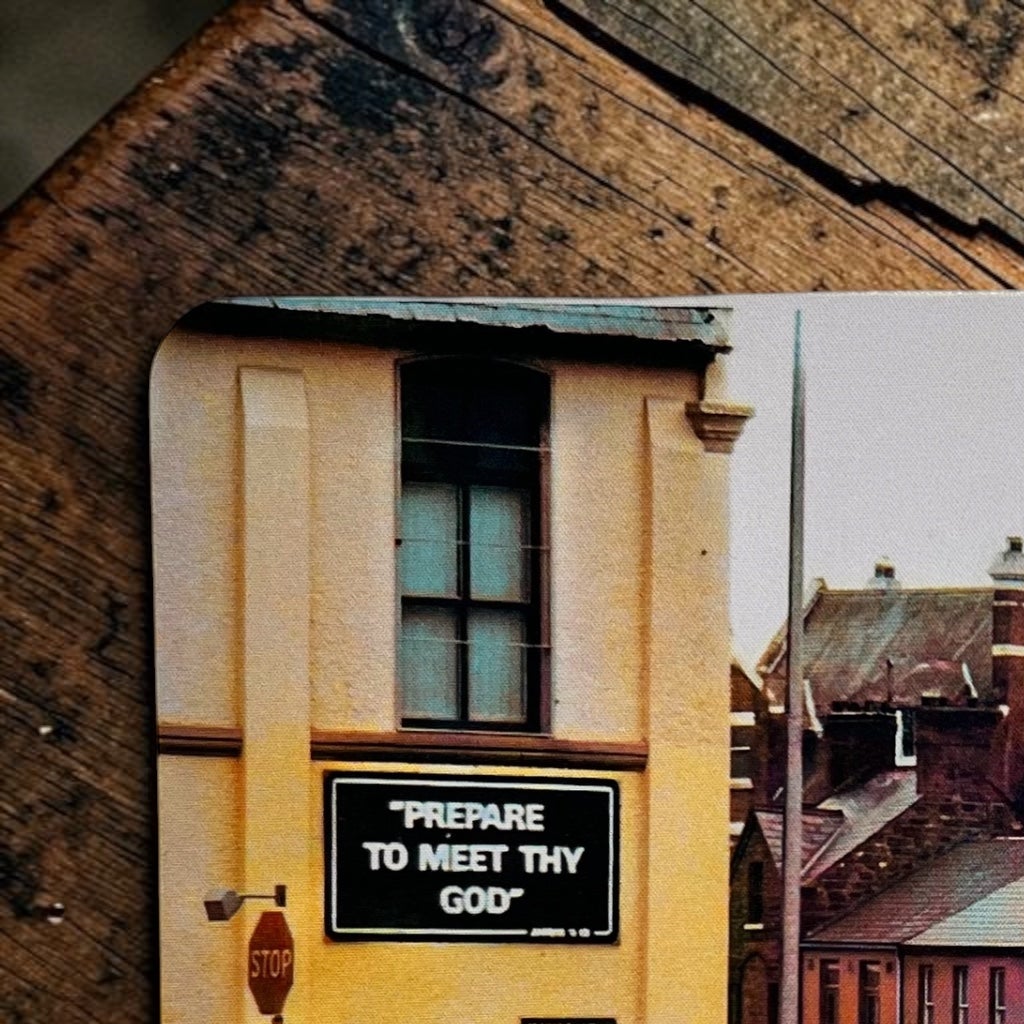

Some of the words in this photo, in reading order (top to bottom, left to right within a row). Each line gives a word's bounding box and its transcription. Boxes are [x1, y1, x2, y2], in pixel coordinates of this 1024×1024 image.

[361, 842, 409, 871] TO
[417, 843, 509, 872] MEET
[518, 845, 586, 874] THY
[251, 949, 292, 978] STOP
